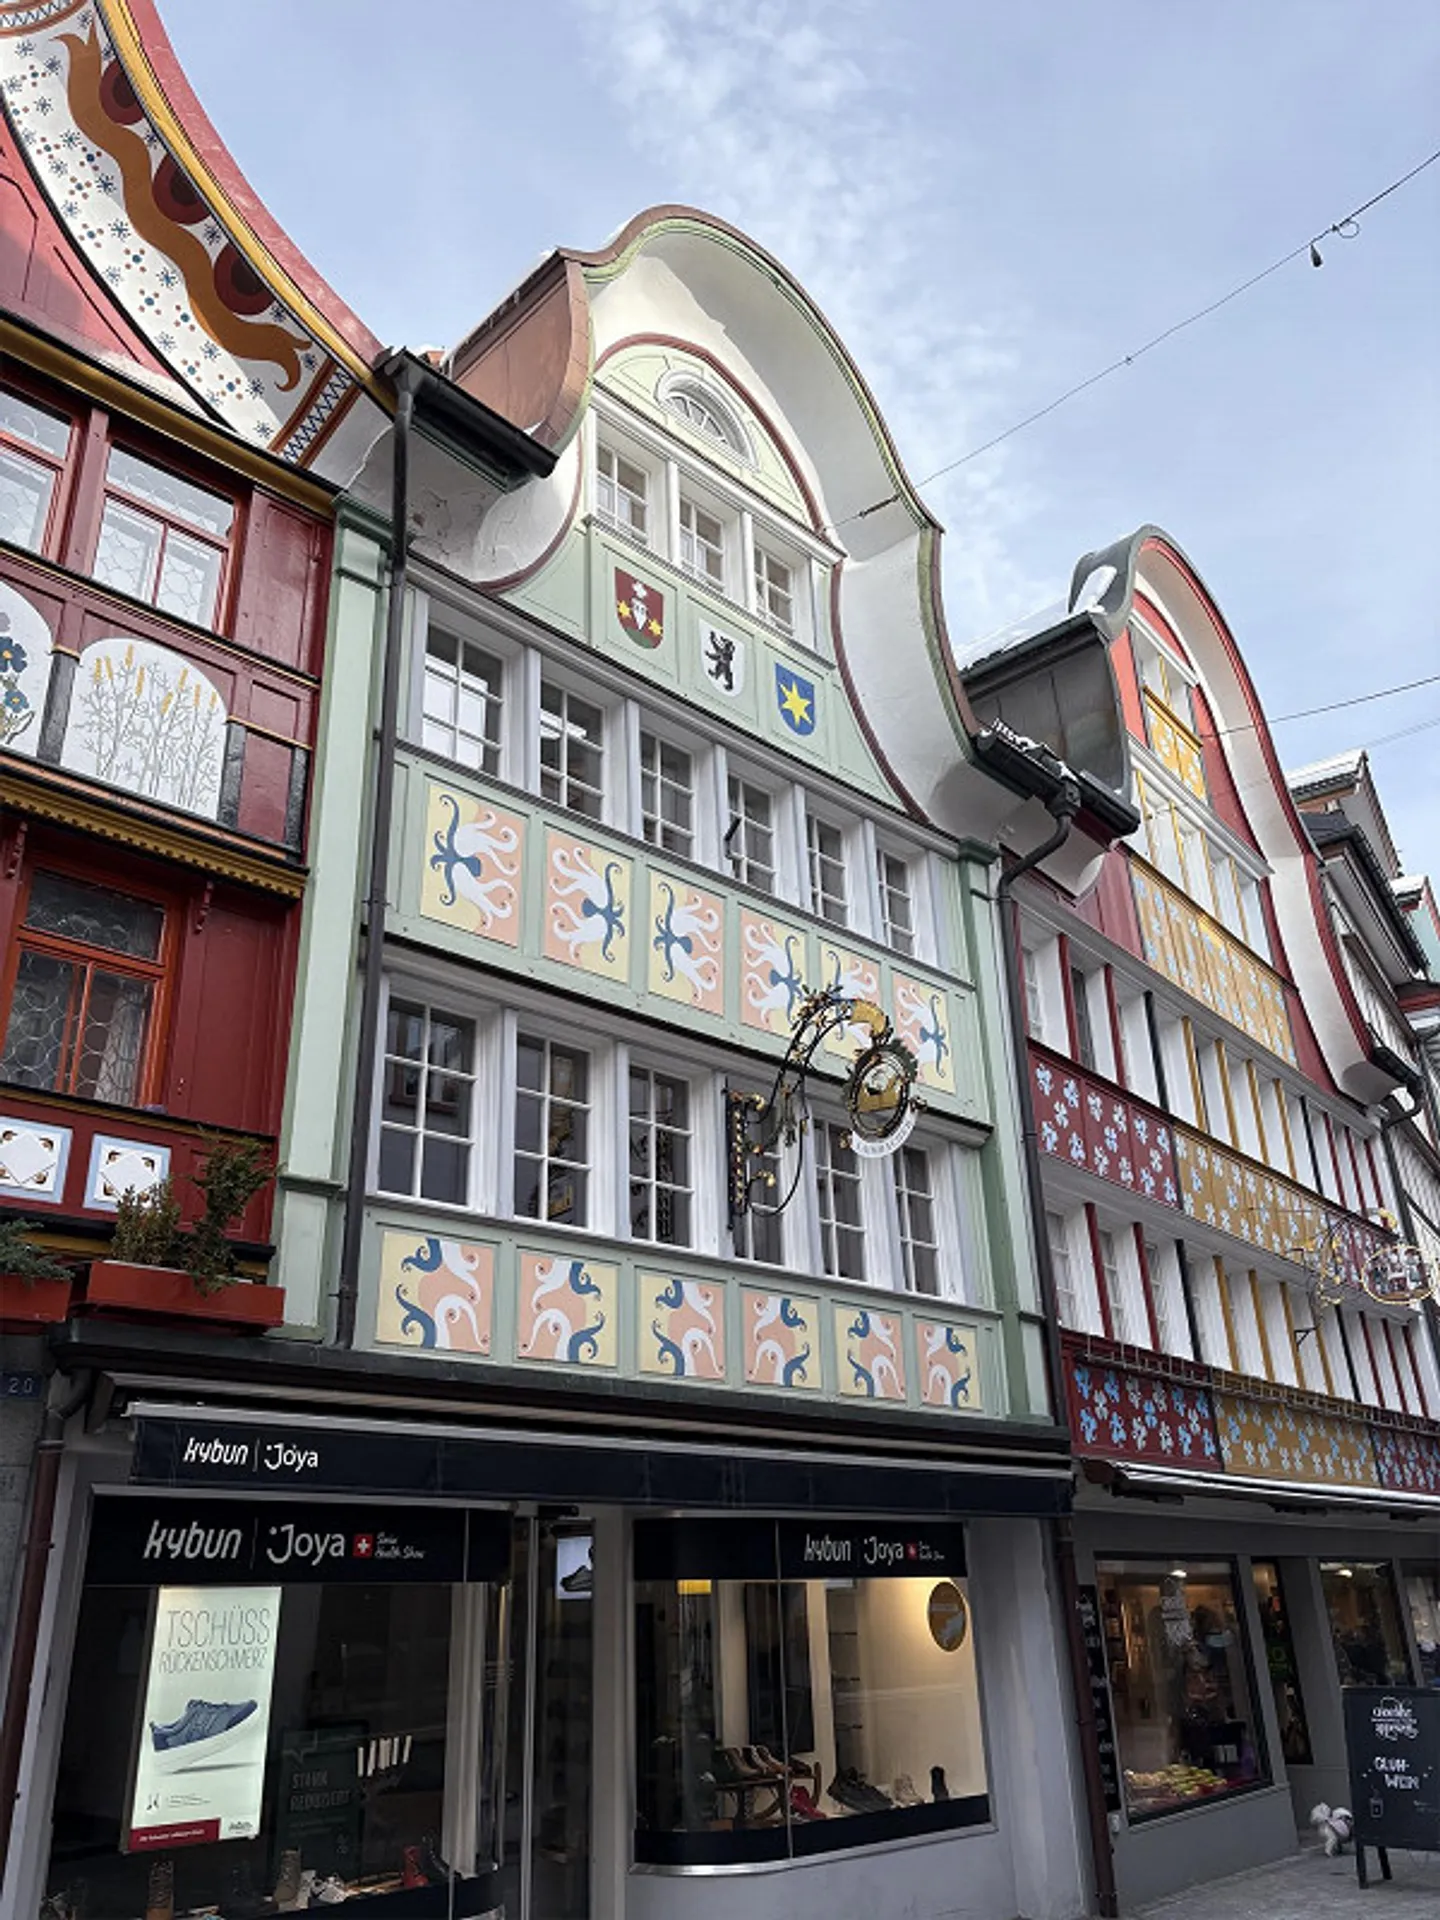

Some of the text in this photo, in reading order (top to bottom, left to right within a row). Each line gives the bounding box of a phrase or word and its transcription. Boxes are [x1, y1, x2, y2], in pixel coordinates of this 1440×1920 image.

[9, 1377, 33, 1393] 20
[183, 1437, 319, 1473] kybun Joya
[143, 1519, 345, 1566] kybun Joya
[804, 1533, 852, 1561] kybun
[863, 1536, 904, 1566] Joya
[167, 1604, 271, 1648] TSCHÜSS
